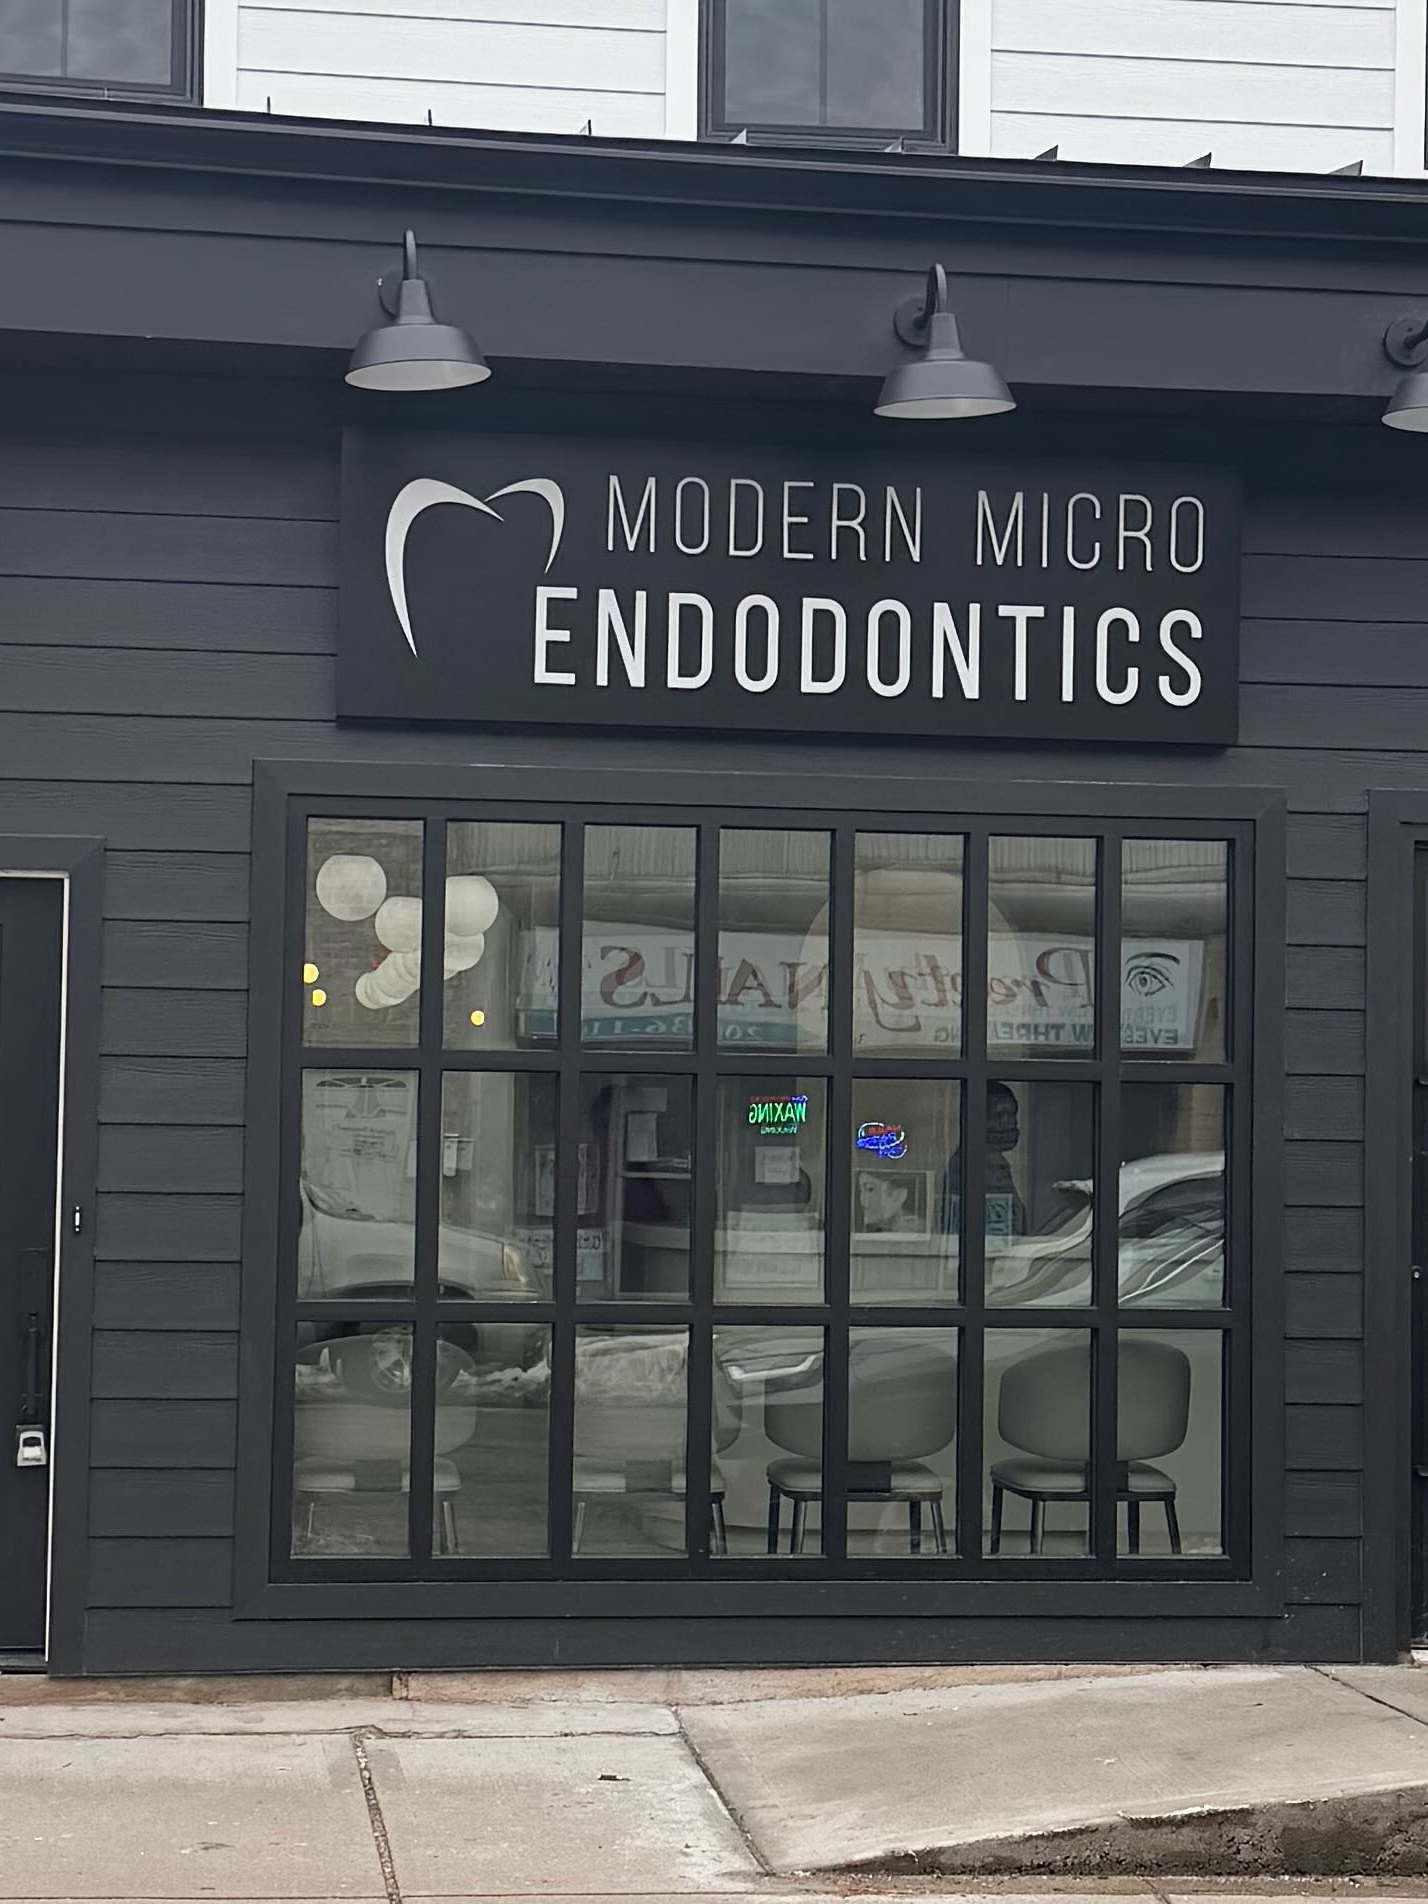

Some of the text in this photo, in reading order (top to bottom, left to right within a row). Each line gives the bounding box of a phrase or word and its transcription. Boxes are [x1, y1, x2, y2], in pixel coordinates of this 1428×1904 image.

[606, 473, 1206, 574] MODERN MICRO
[532, 585, 1205, 708] ENDODONTICS
